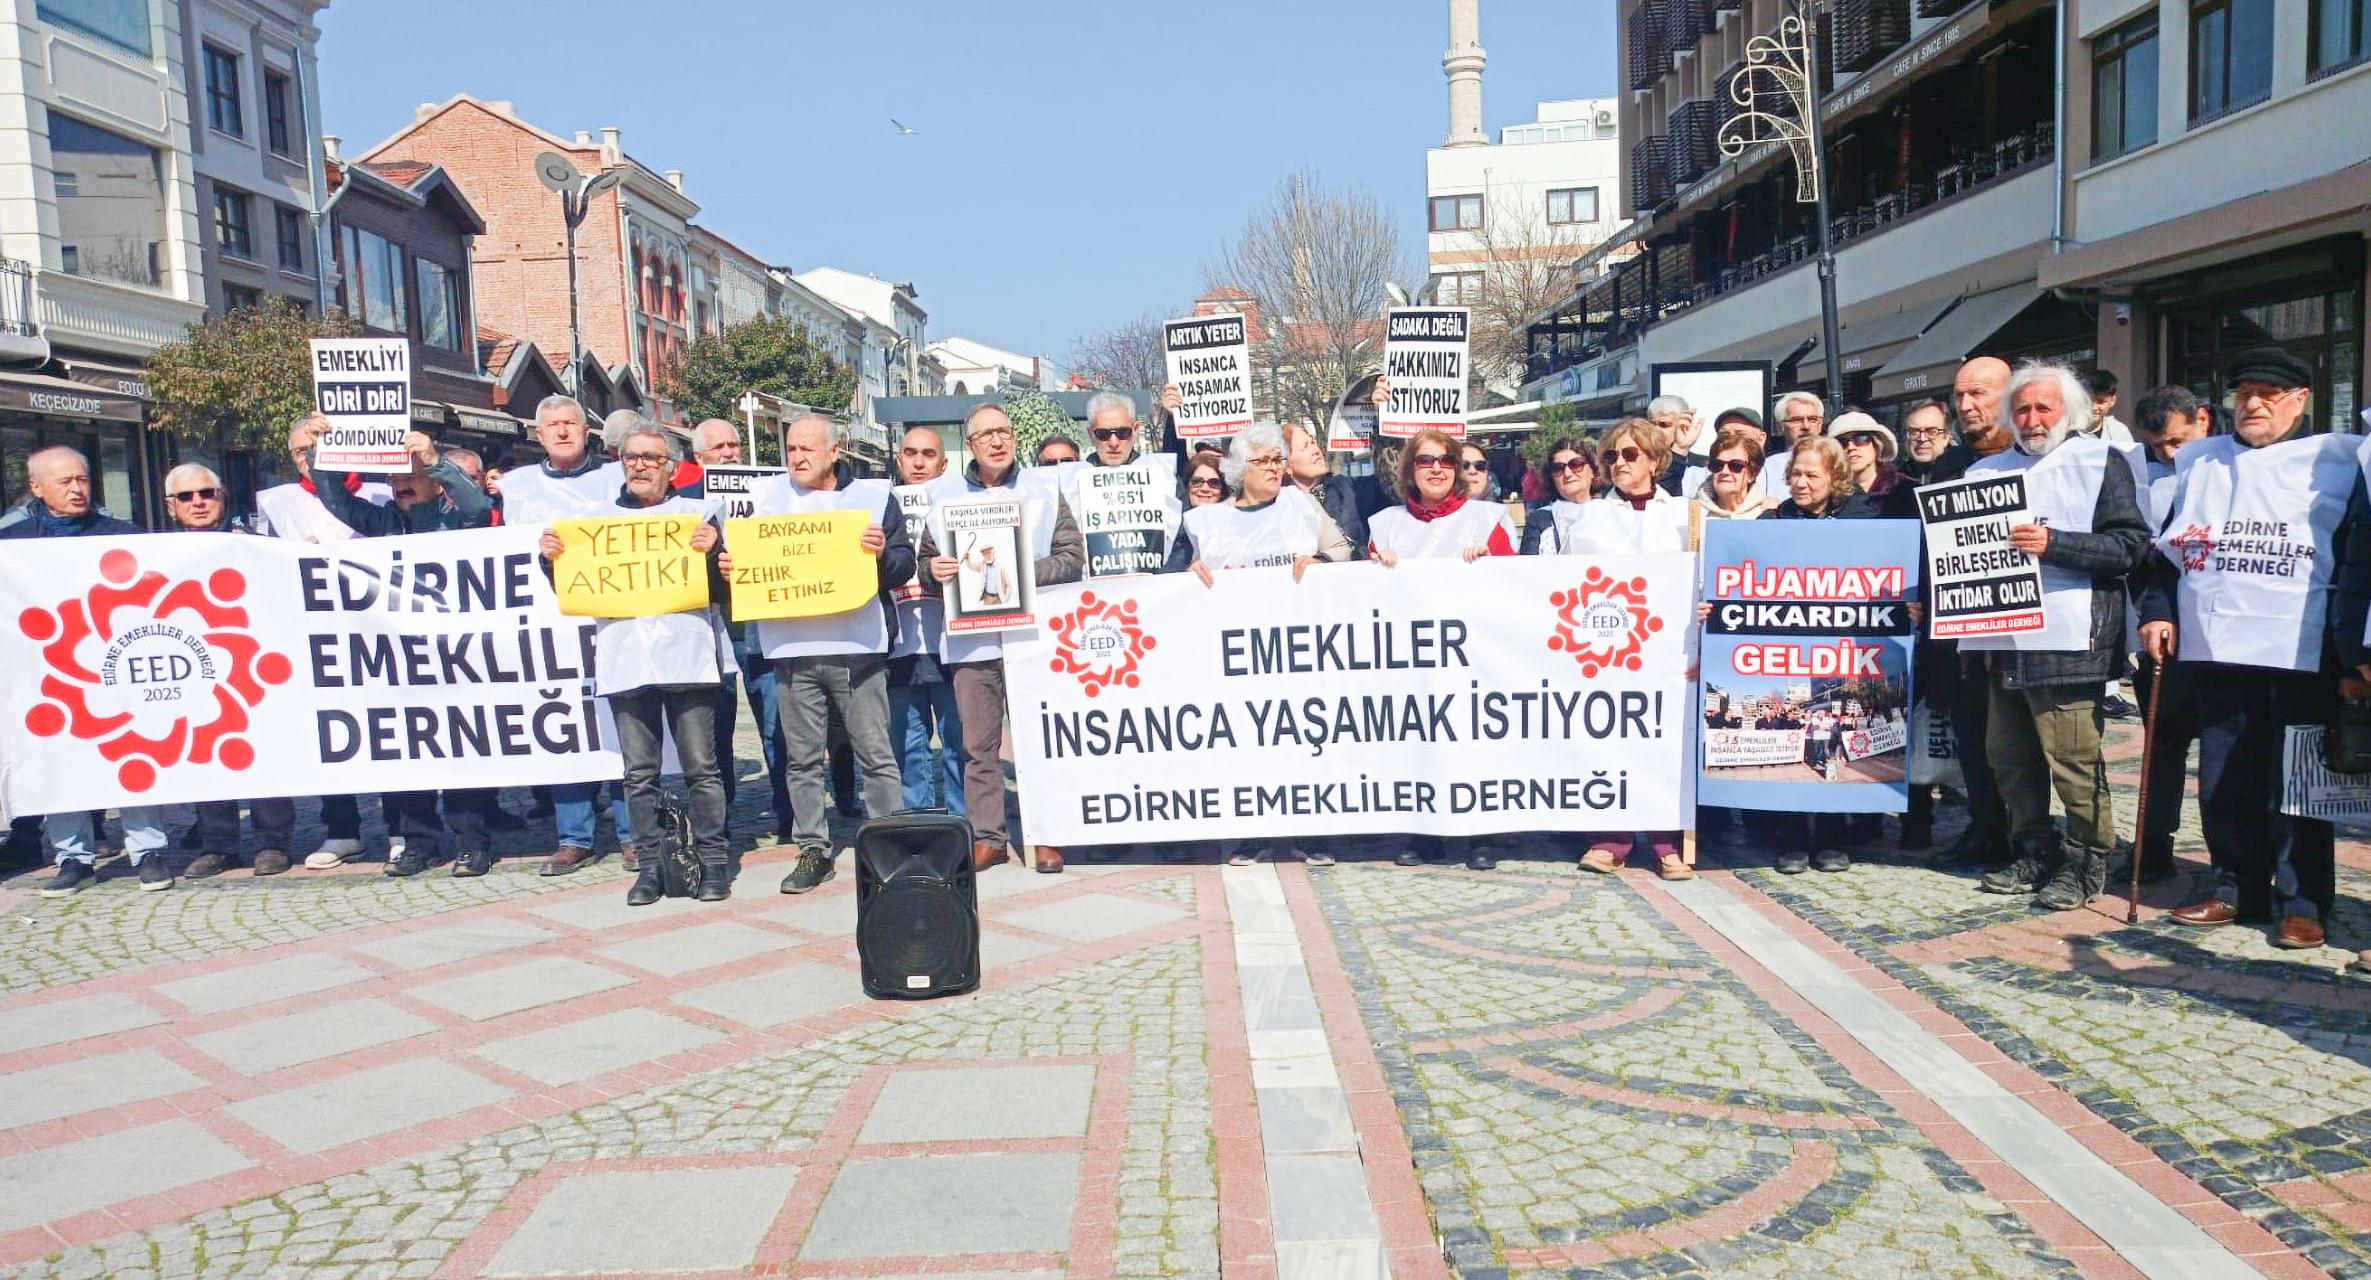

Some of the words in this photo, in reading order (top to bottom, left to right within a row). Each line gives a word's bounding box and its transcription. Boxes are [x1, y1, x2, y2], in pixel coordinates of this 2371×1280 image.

[1170, 326, 1204, 347] ARTIK
[1205, 322, 1242, 343] YETER
[1391, 317, 1430, 337] SADAKA
[1432, 313, 1464, 337] DEĞİL
[317, 345, 404, 372] EMEKLİYİ
[1179, 355, 1238, 375] İNSANCA
[1388, 351, 1461, 378] HAKKIMIZI
[118, 380, 144, 396] FOTO
[322, 385, 362, 412] DİRİ
[367, 385, 403, 411] DİRİ
[1179, 376, 1241, 397] YAŞAMAK
[29, 391, 101, 414] KEÇECİZADE
[323, 426, 406, 446] GÖMDÜNÜZ
[1093, 468, 1151, 488] EMEKLİ
[1928, 495, 1947, 516] 17
[1952, 483, 2020, 513] MİLYON
[758, 520, 832, 539] BAYRAMI
[1086, 510, 1100, 530] İŞ
[1107, 510, 1164, 525] ARIYOR
[1955, 516, 2012, 547] EMEKLİ
[2222, 518, 2288, 537] EDİRNE
[578, 520, 684, 557] YETER
[783, 541, 816, 557] BİZE
[1108, 532, 1146, 549] YADA
[2217, 539, 2317, 561] EMEKLİLER
[736, 562, 795, 585] ZEHİR
[1092, 552, 1162, 575] ÇALIŞIYOR
[1936, 547, 2031, 577] BİRLEŞEREK
[2216, 557, 2297, 578] DERNEĞİ
[298, 550, 534, 612] EDİRNE
[568, 555, 689, 595] ARTIK!
[1717, 560, 1904, 599] PİJAMAYI
[1938, 583, 1994, 611] İKTİDAR
[1999, 580, 2037, 605] OLUR
[1592, 615, 1619, 628] EED
[1721, 604, 1896, 630] ÇIKARDIK
[1965, 619, 2007, 632] EMEKLİLER
[2008, 614, 2041, 629] DERNEĞİ
[101, 645, 122, 686] EDİRNE
[117, 623, 183, 648] EMEKLİLER
[184, 634, 216, 680] DERNEĞİ
[308, 615, 598, 687] EMEKLİLE
[1090, 637, 1115, 650] EED
[1221, 608, 1470, 677] EMEKLİLER
[128, 654, 192, 684] EED
[1732, 638, 1884, 678] GELDİK
[143, 687, 182, 702] 2025
[316, 686, 601, 763] DERNEĞİ
[1041, 701, 1238, 759] İNSANCA
[1245, 693, 1458, 757] YAŞAMAK
[1471, 679, 1663, 740] İSTİYOR!
[1081, 784, 1222, 825] EDİRNE
[1234, 773, 1437, 817] EMEKLİLER
[1450, 770, 1628, 814] DERNEĞİ
